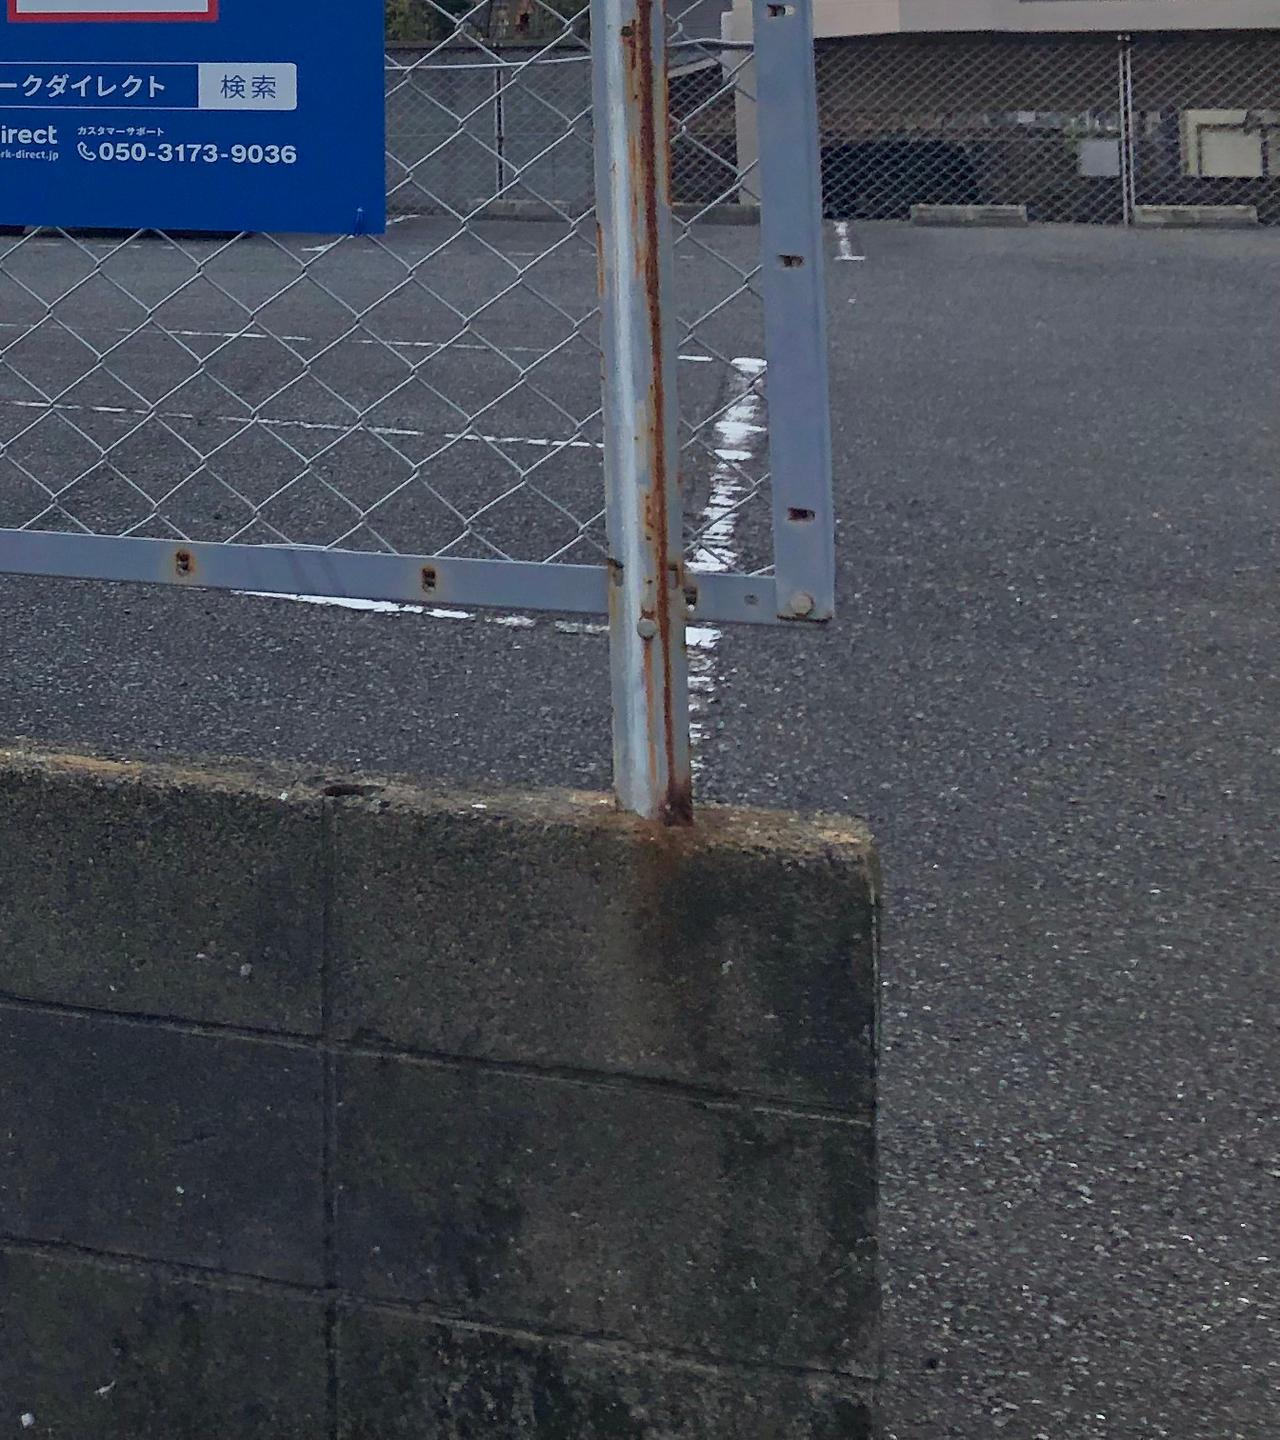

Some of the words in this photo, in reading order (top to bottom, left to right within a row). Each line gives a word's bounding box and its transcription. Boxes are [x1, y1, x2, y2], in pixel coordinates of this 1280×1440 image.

[220, 74, 277, 99] 検索
[77, 126, 165, 137] カスタマーサポート
[98, 142, 298, 164] 050-3173-9036
